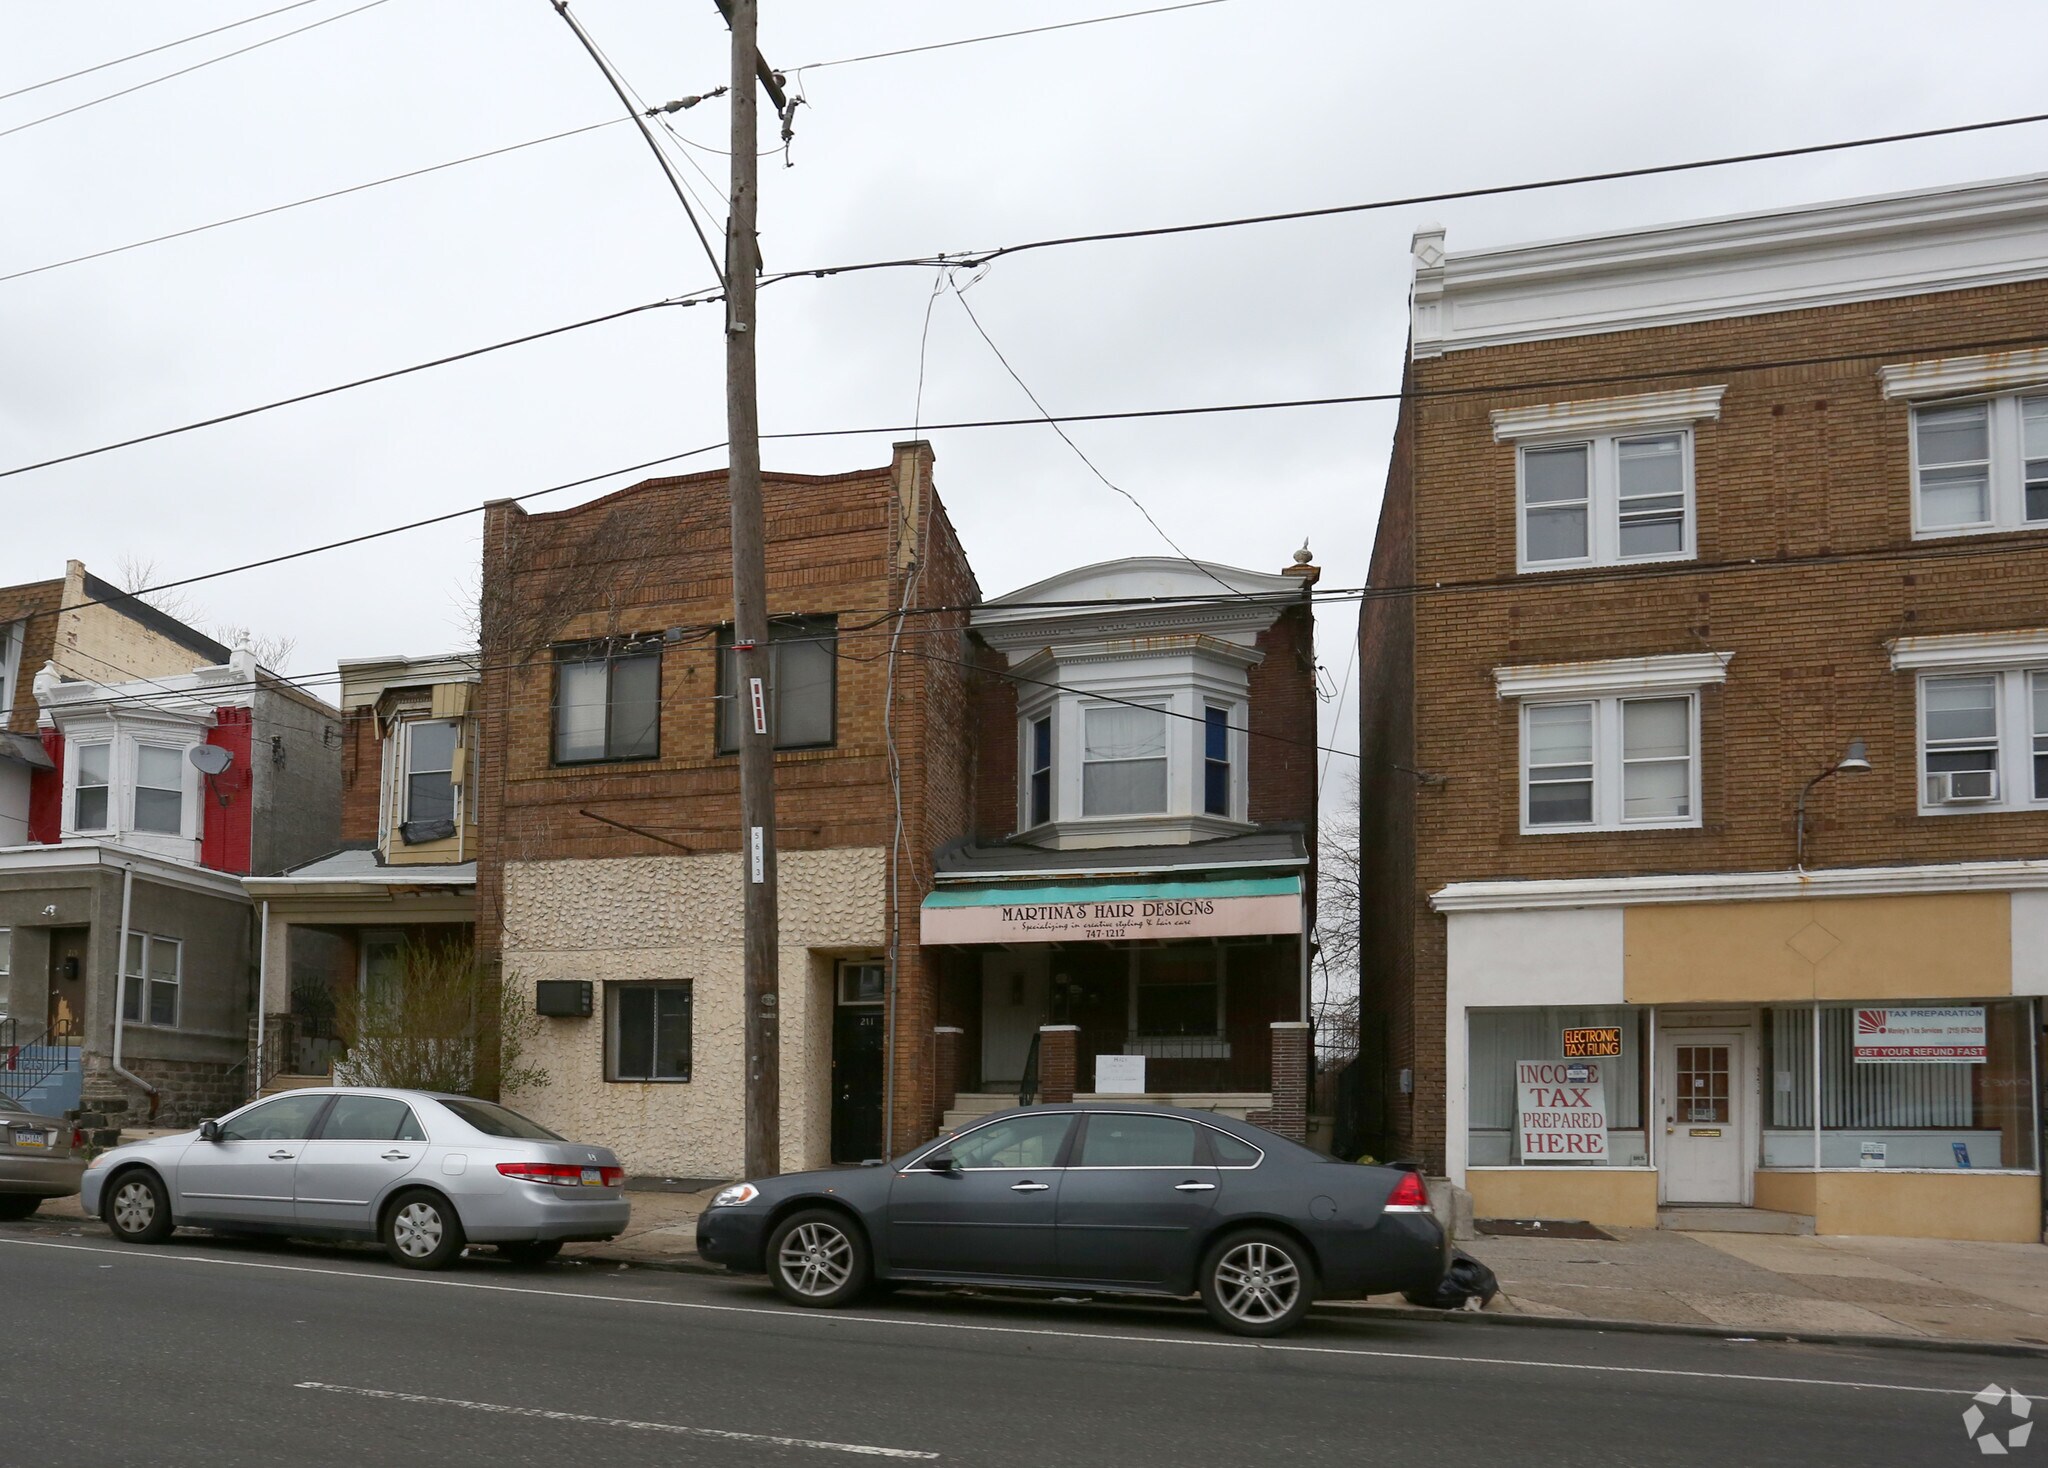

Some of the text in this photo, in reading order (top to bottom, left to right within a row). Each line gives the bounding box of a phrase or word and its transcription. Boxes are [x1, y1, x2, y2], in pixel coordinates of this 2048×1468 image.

[1002, 900, 1214, 921] MARTINA'S HAIR DESIGNS
[1022, 921, 1068, 932] Specializing
[1071, 921, 1081, 929] in
[1083, 920, 1112, 929] creative
[1115, 918, 1143, 930] styling
[1146, 918, 1153, 926] &
[1156, 918, 1171, 926] hair
[1086, 928, 1126, 938] 747-1212
[1888, 1009, 1983, 1018] TAX PREPARATION
[860, 1017, 874, 1026] 211
[1565, 1029, 1619, 1043] ELECTRONIC
[1911, 1026, 1920, 1034] Tax
[1921, 1026, 1943, 1034] Services
[1565, 1042, 1619, 1056] TAX FILING
[1858, 1047, 1984, 1056] GET YOUR REFUND FAST
[1520, 1064, 1600, 1084] INCOE
[1530, 1087, 1592, 1108] TAX
[1523, 1112, 1603, 1129] PREPARED
[1524, 1133, 1604, 1154] HERE
